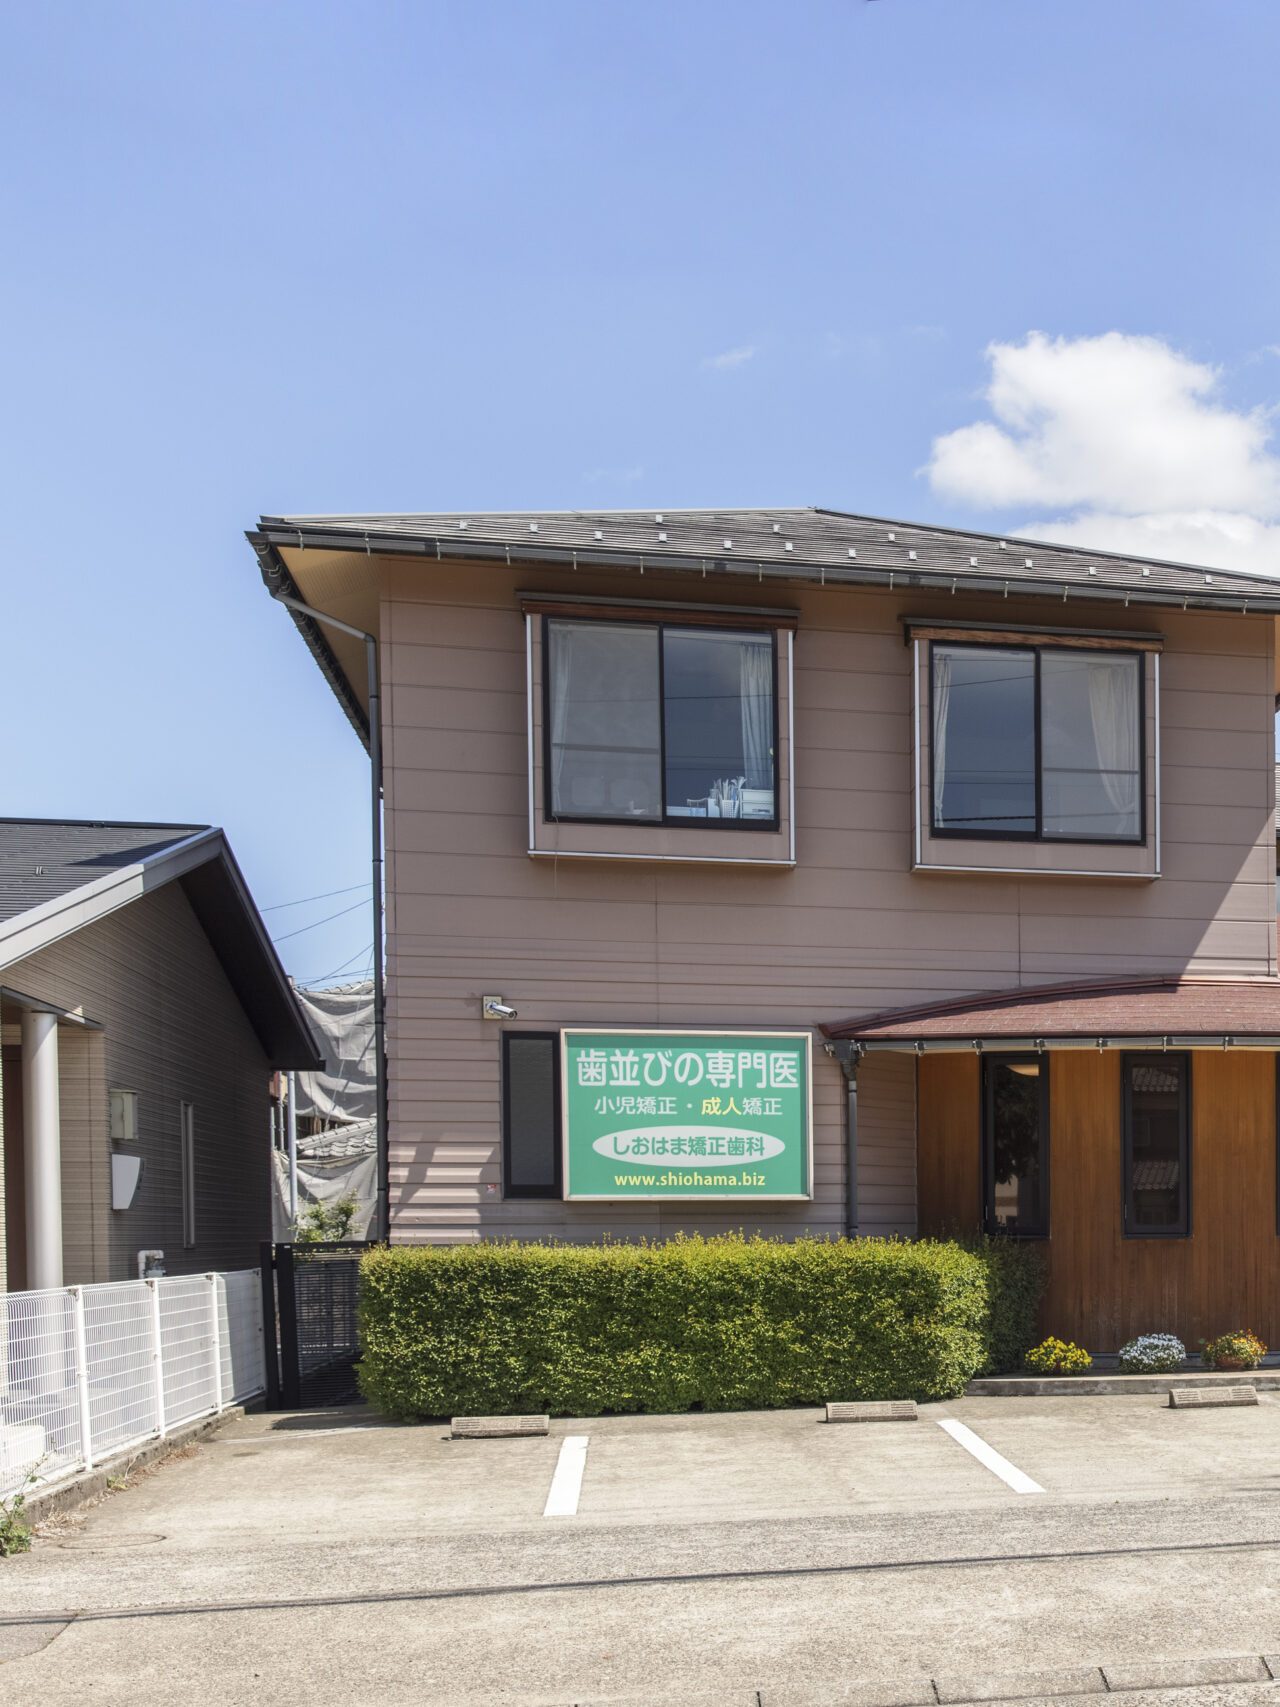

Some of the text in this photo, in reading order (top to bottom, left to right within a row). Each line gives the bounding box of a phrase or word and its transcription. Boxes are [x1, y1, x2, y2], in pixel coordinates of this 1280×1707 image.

[576, 1049, 799, 1089] 歯並びの専門医
[613, 1136, 765, 1156] しおはま矯正歯科
[614, 1171, 766, 1186] www.shiohama.biz
